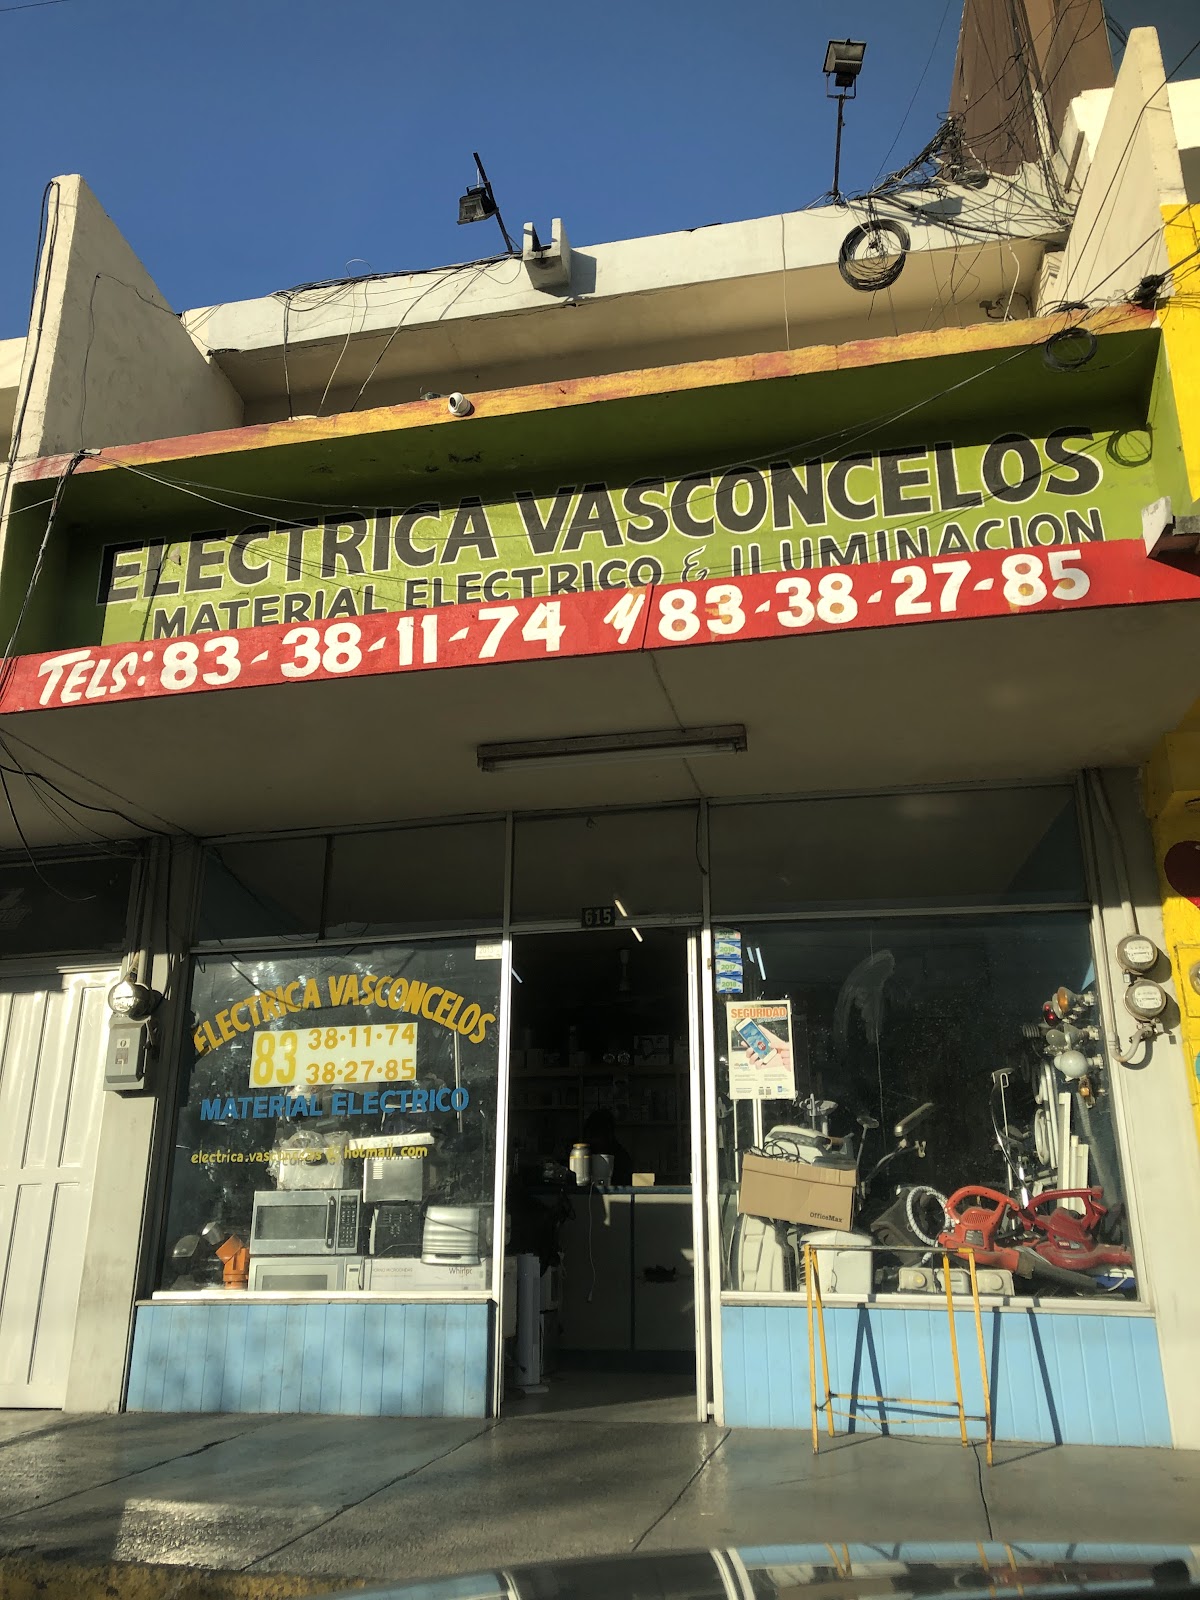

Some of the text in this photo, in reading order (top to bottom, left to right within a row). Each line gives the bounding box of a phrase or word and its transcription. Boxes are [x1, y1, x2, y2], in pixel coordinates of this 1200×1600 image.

[97, 426, 1104, 606] ELECTRICA VASCONCELOS
[153, 574, 389, 641] MATERIAL
[405, 555, 664, 612] ELECTRICO
[733, 508, 1107, 578] ILUMINACION
[585, 909, 611, 925] 615
[192, 974, 496, 1056] ELECTRICA VASCONCELOS
[730, 1007, 787, 1019] SEGURIDAD
[253, 1031, 298, 1085] 83
[201, 1087, 470, 1121] MATERIAL ELECTRICO
[809, 1211, 843, 1223] OfficeMax
